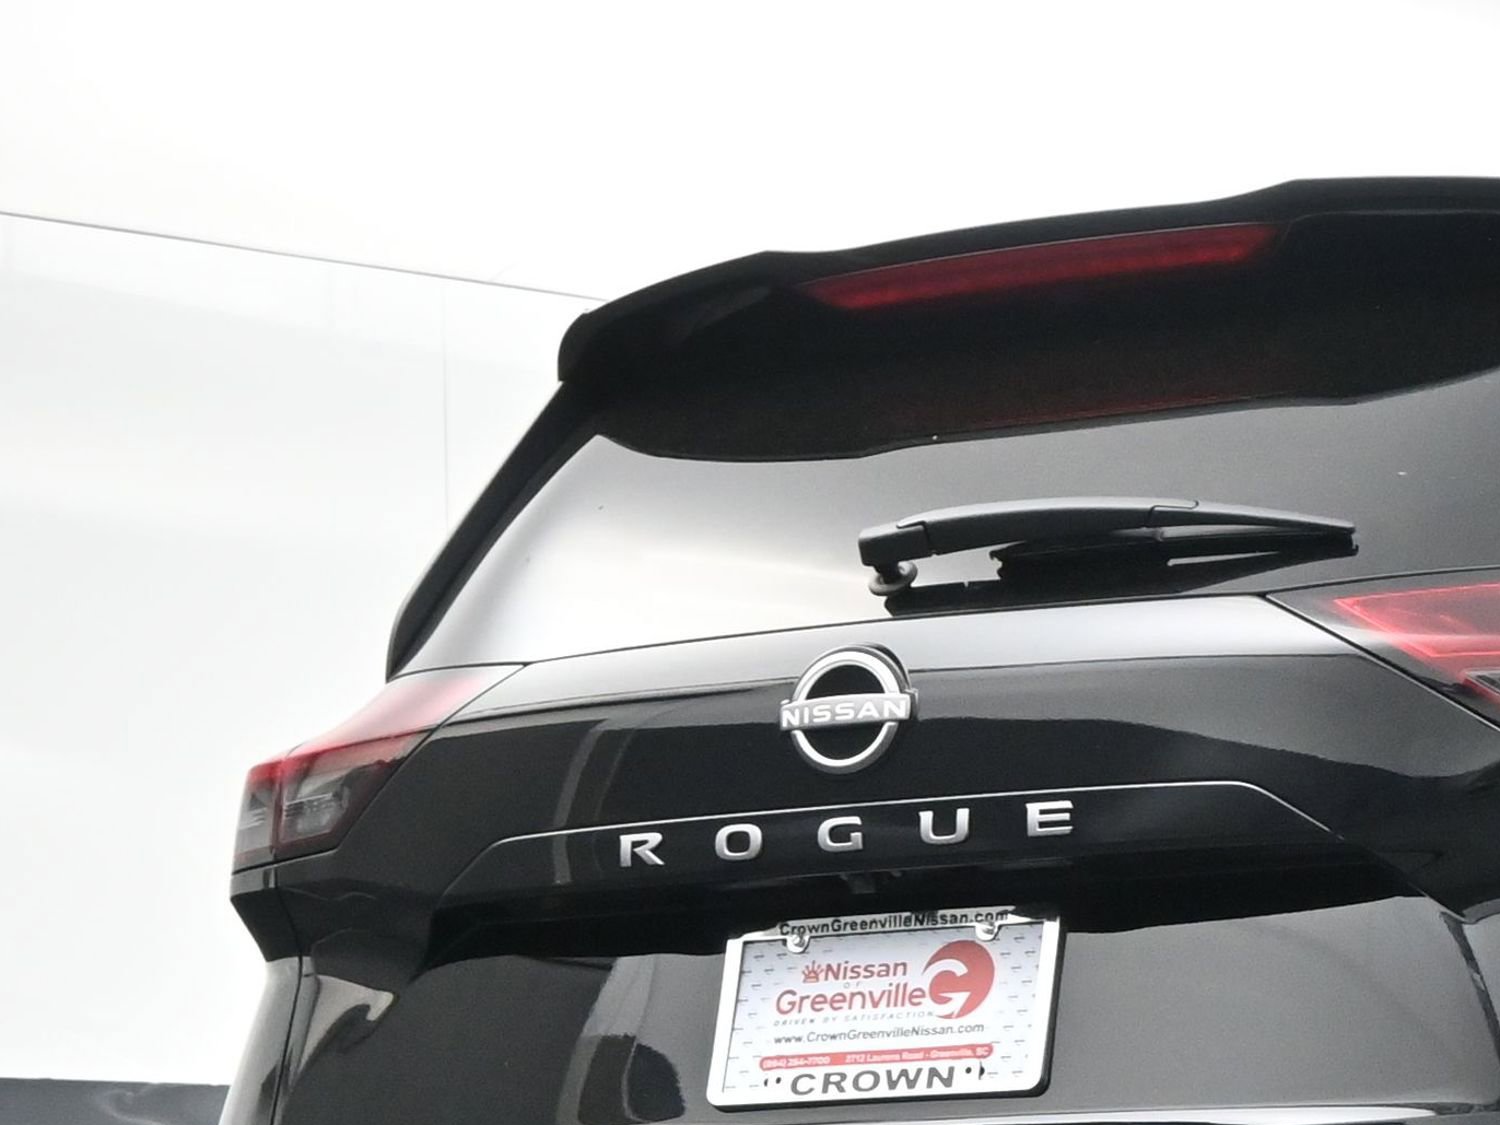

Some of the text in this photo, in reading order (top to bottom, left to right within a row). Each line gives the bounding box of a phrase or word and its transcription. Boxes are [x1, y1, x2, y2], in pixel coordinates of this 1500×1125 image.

[781, 700, 906, 728] NISSAN
[619, 800, 1075, 867] ROGUE
[780, 908, 1009, 936] CrownGreenvilleNissan.com
[824, 961, 908, 982] Nissan
[776, 982, 927, 1015] Greenville
[774, 1023, 985, 1044] www.CrownGreenvilleNissan.com
[790, 1066, 955, 1096] CROWN
